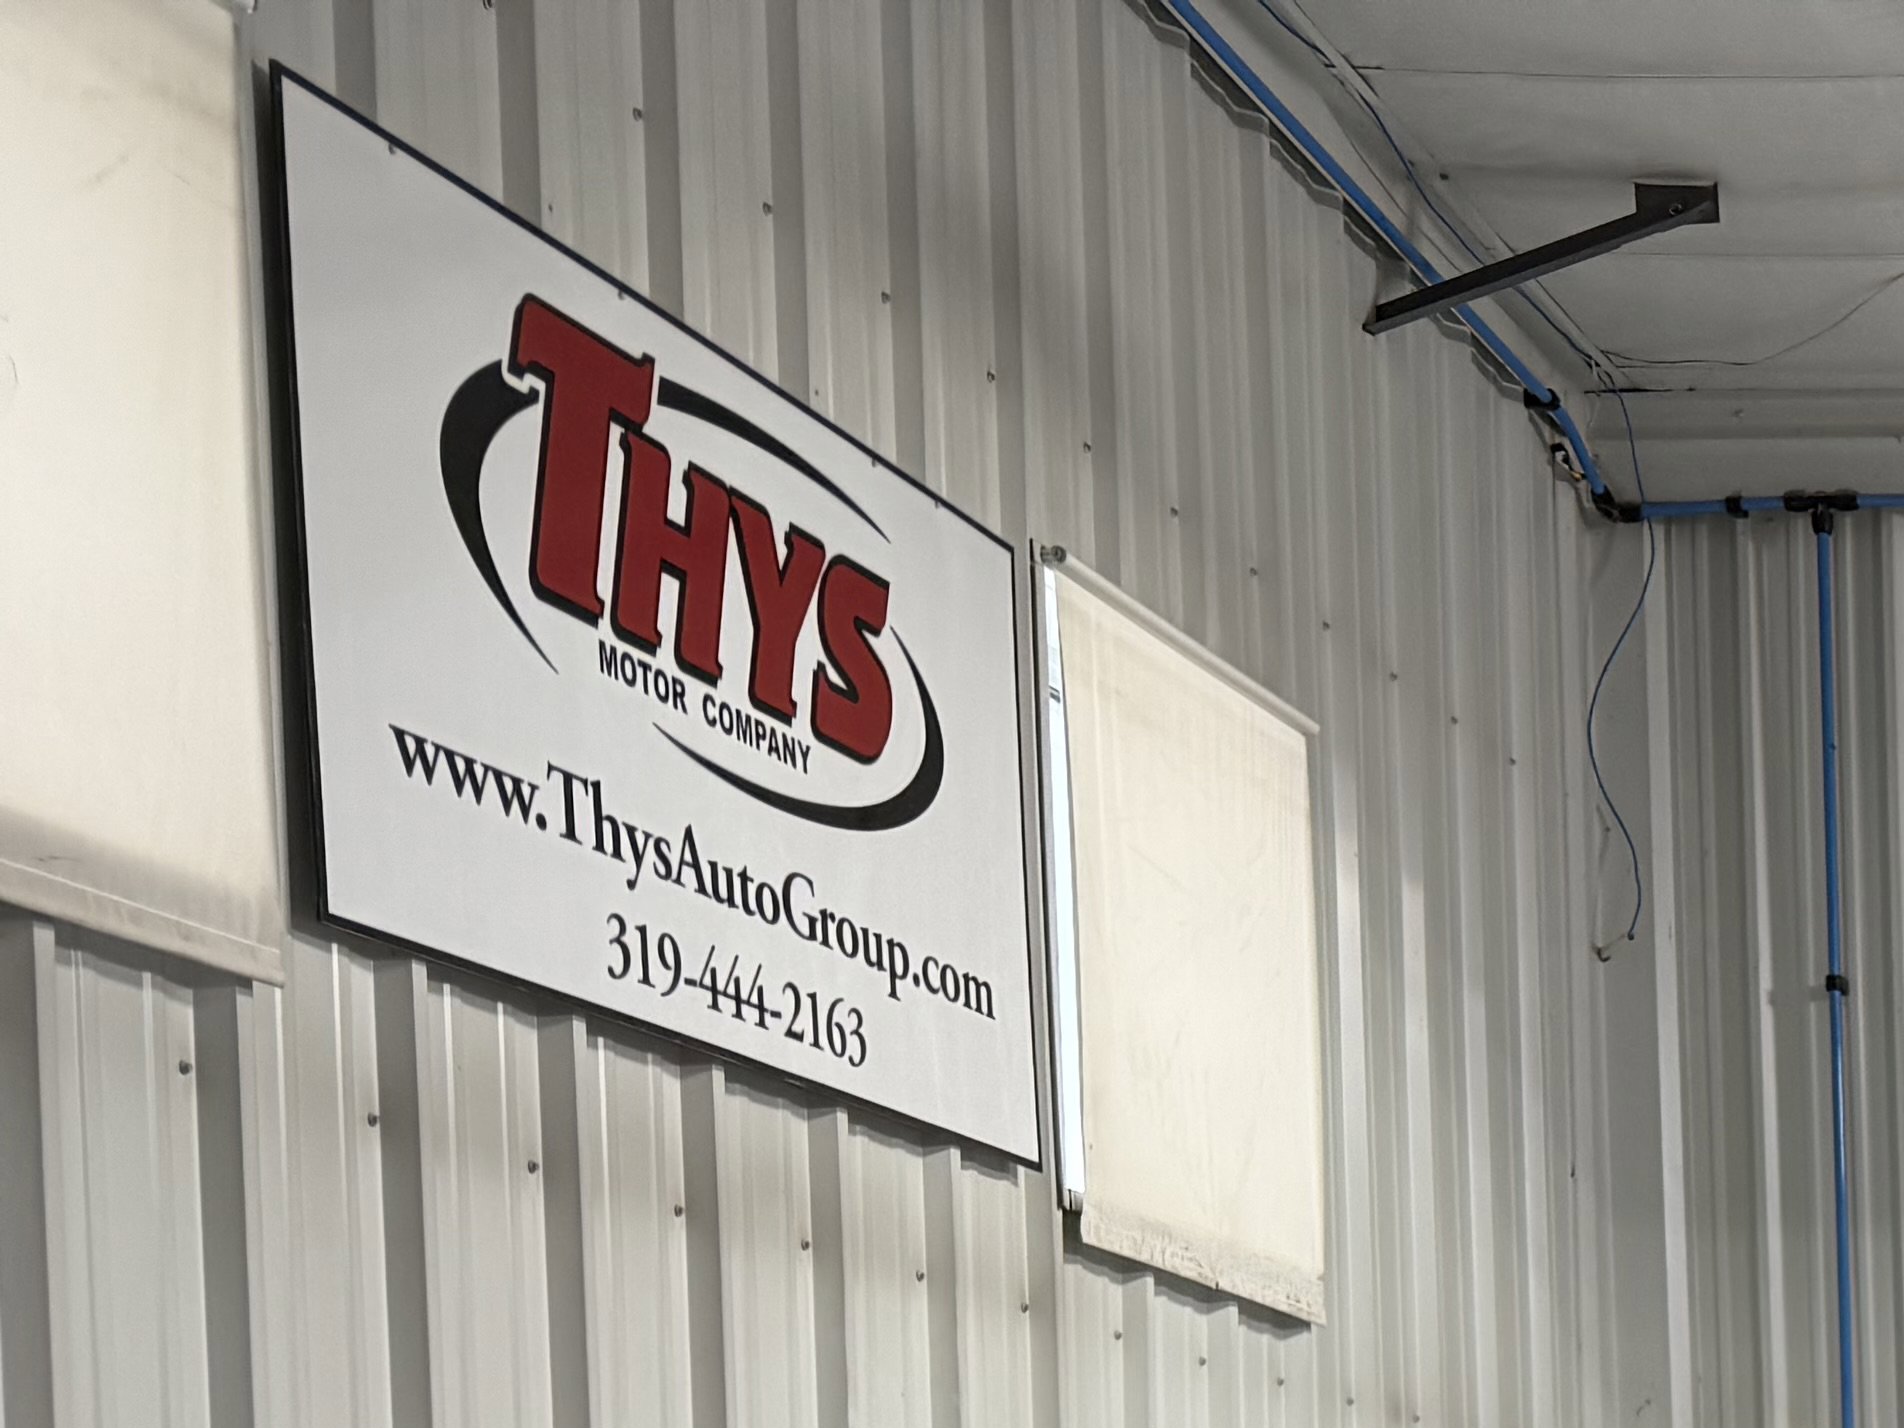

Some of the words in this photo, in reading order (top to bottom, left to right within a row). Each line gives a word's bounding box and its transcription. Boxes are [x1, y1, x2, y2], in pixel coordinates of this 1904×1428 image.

[508, 293, 893, 765] THYS
[599, 639, 688, 715] MOTOR
[702, 694, 811, 774] COMPANY
[389, 724, 996, 1020] www.ThysAutoGroup.com
[606, 913, 869, 1067] 319-444-2163
